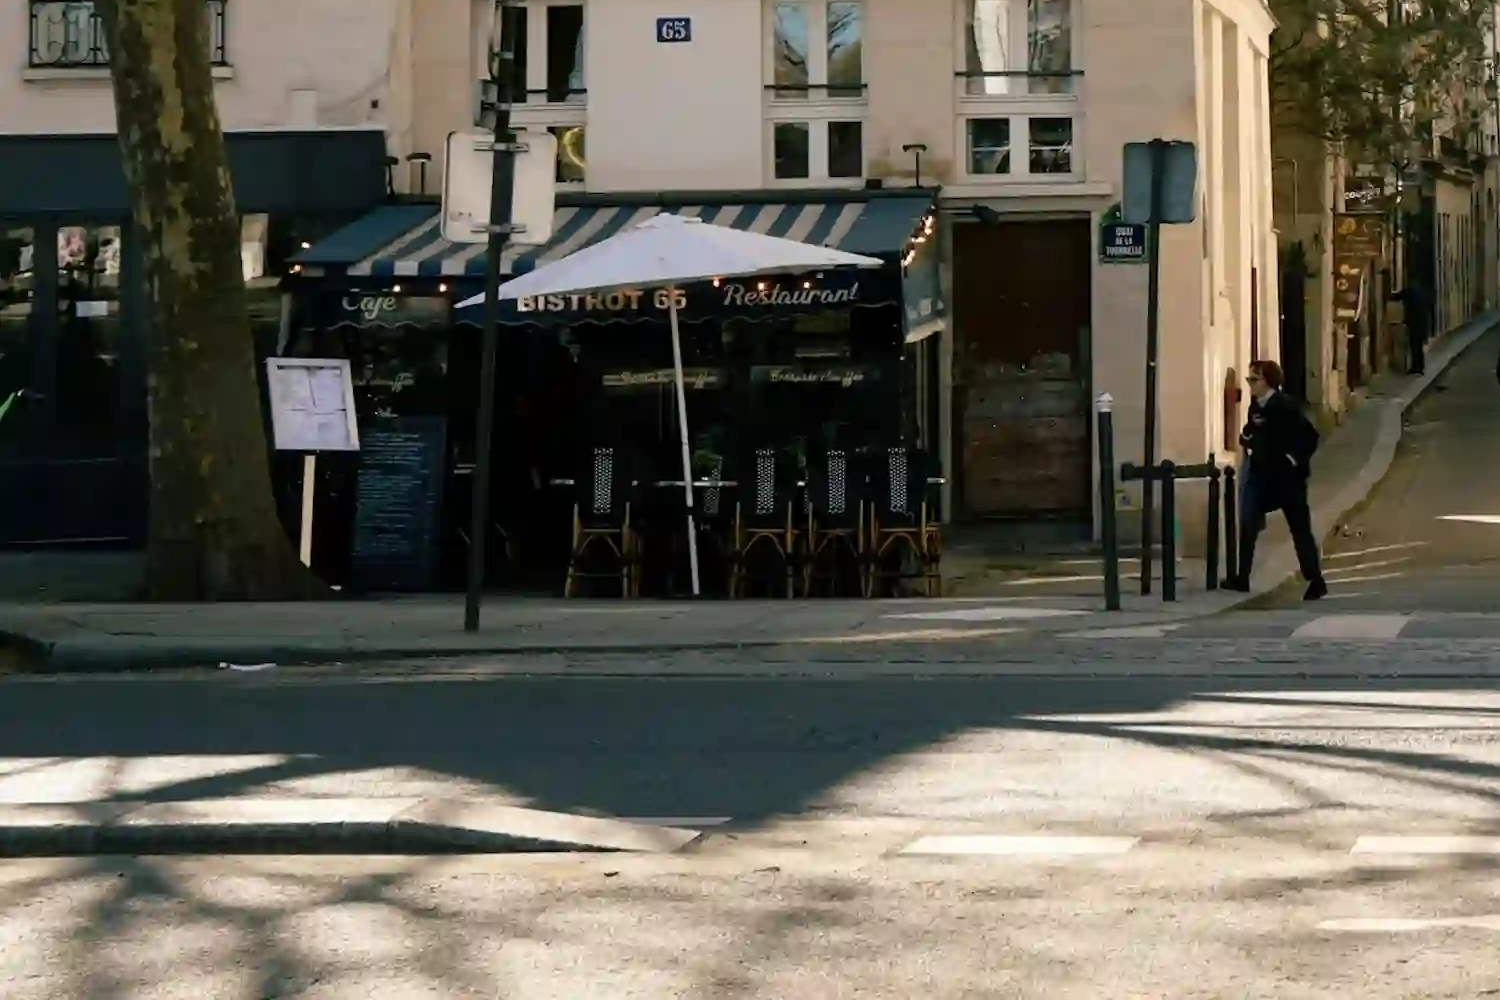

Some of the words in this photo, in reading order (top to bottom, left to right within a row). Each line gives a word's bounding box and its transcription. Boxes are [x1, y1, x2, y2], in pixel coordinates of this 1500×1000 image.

[662, 20, 686, 40] 65
[516, 291, 644, 312] BISTROT
[653, 288, 688, 310] 65
[723, 282, 859, 306] Restaurant
